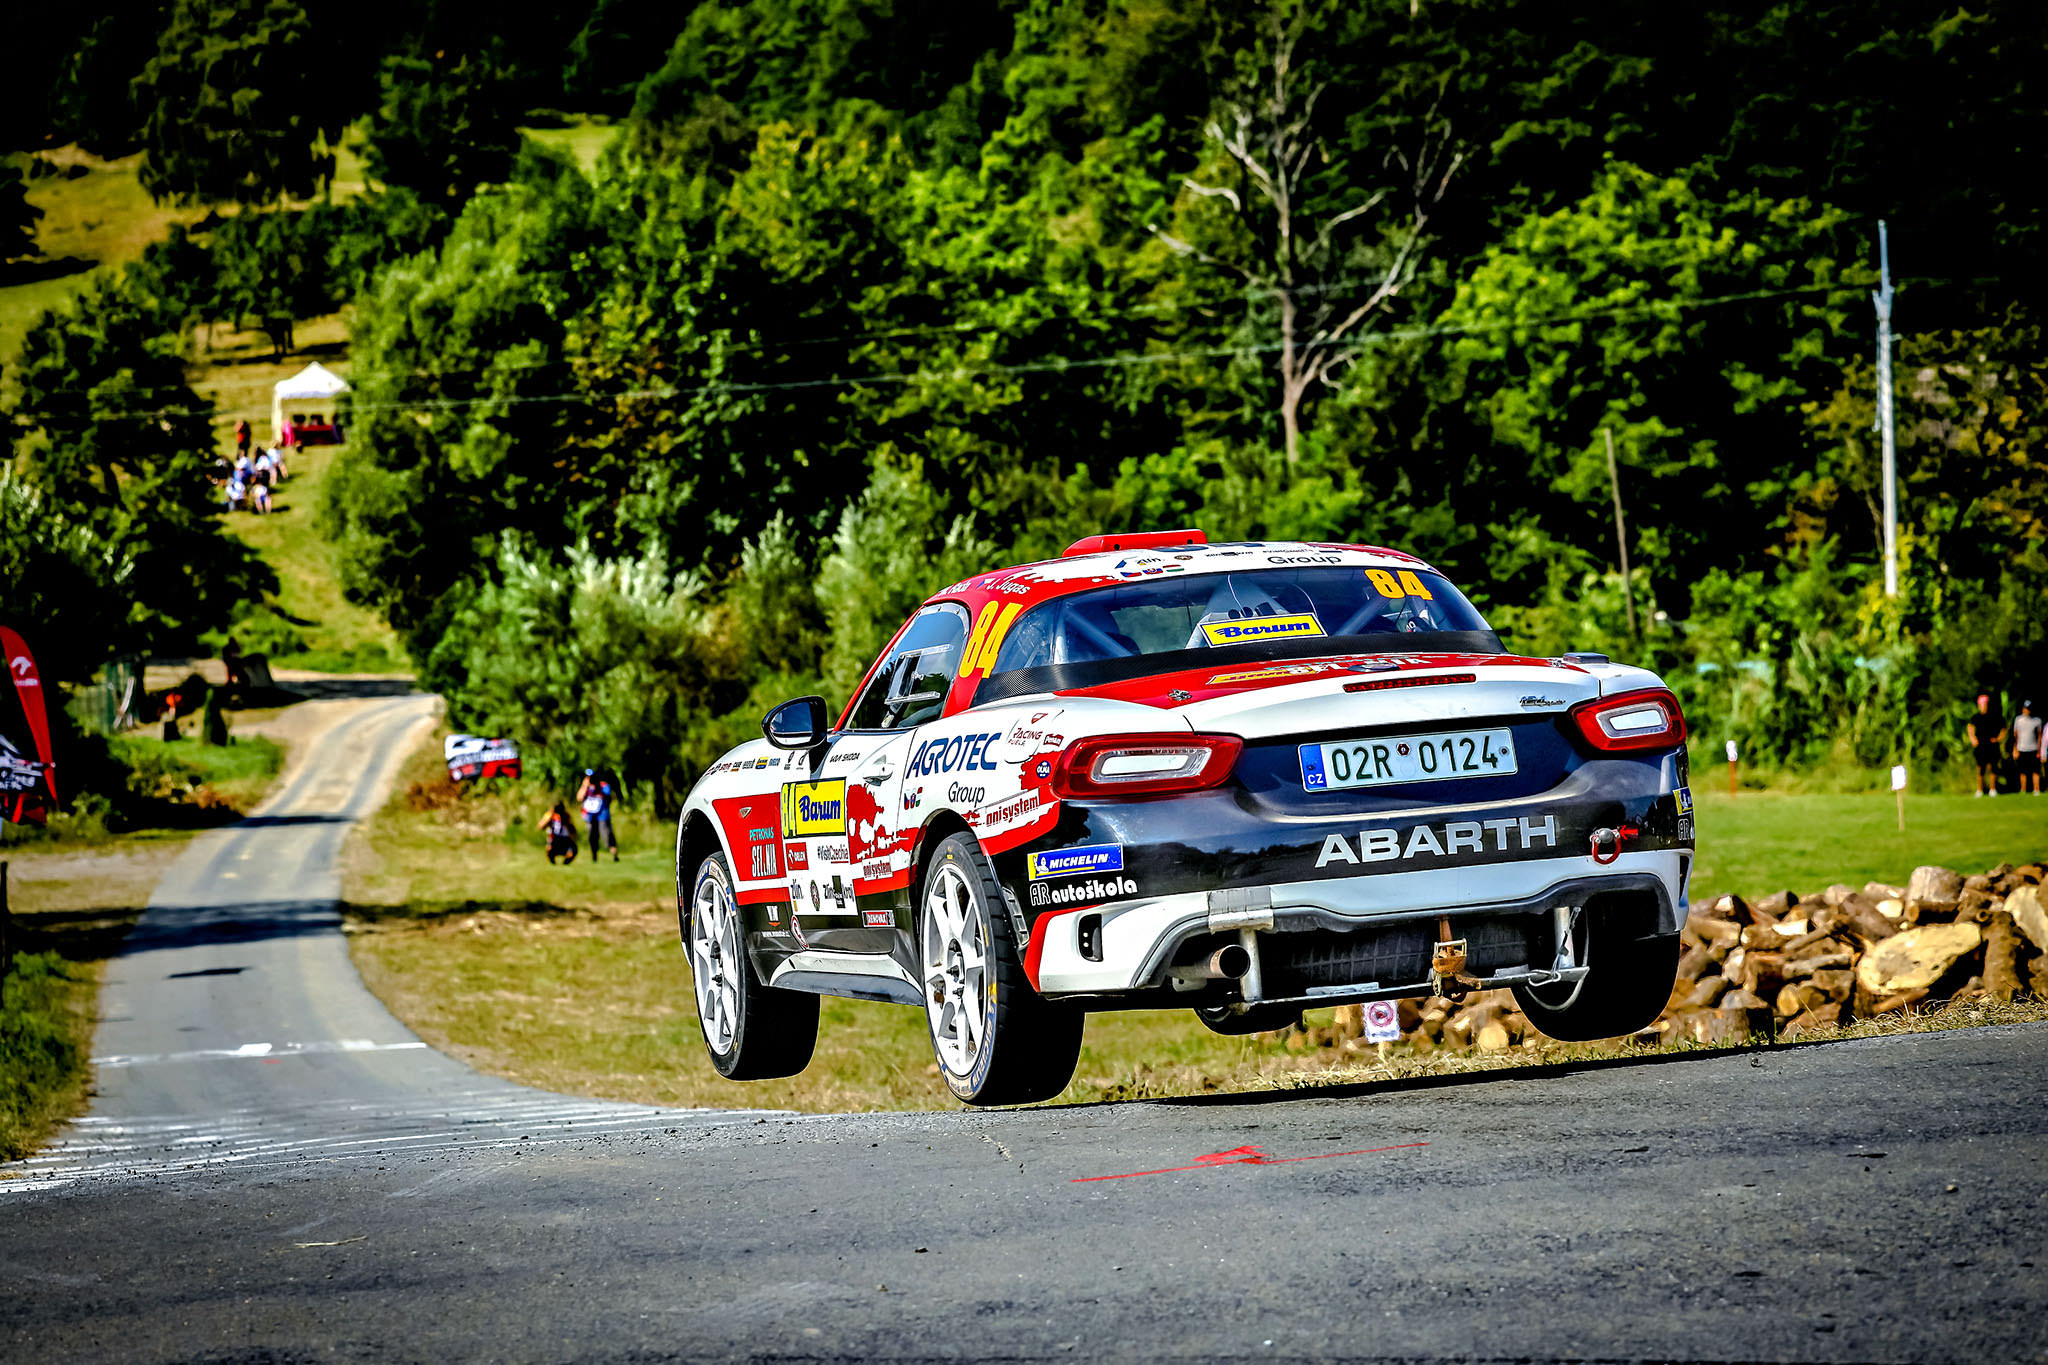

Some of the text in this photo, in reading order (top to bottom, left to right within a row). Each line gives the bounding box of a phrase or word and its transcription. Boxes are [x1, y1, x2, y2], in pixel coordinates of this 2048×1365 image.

[1267, 556, 1342, 564] Group
[1364, 568, 1434, 601] 84
[959, 600, 1024, 679] 84
[1214, 622, 1311, 638] Barum
[1013, 727, 1043, 740] RACING
[905, 732, 1002, 779] AGROTEC
[1331, 735, 1499, 781] 02R 0124
[1307, 773, 1324, 785] CZ
[948, 781, 985, 808] Group
[798, 795, 841, 822] Barum
[749, 826, 775, 841] PETRONAS
[1314, 815, 1556, 869] ABARTH
[1049, 853, 1109, 869] MICHELIN
[1051, 876, 1138, 904] autoškola
